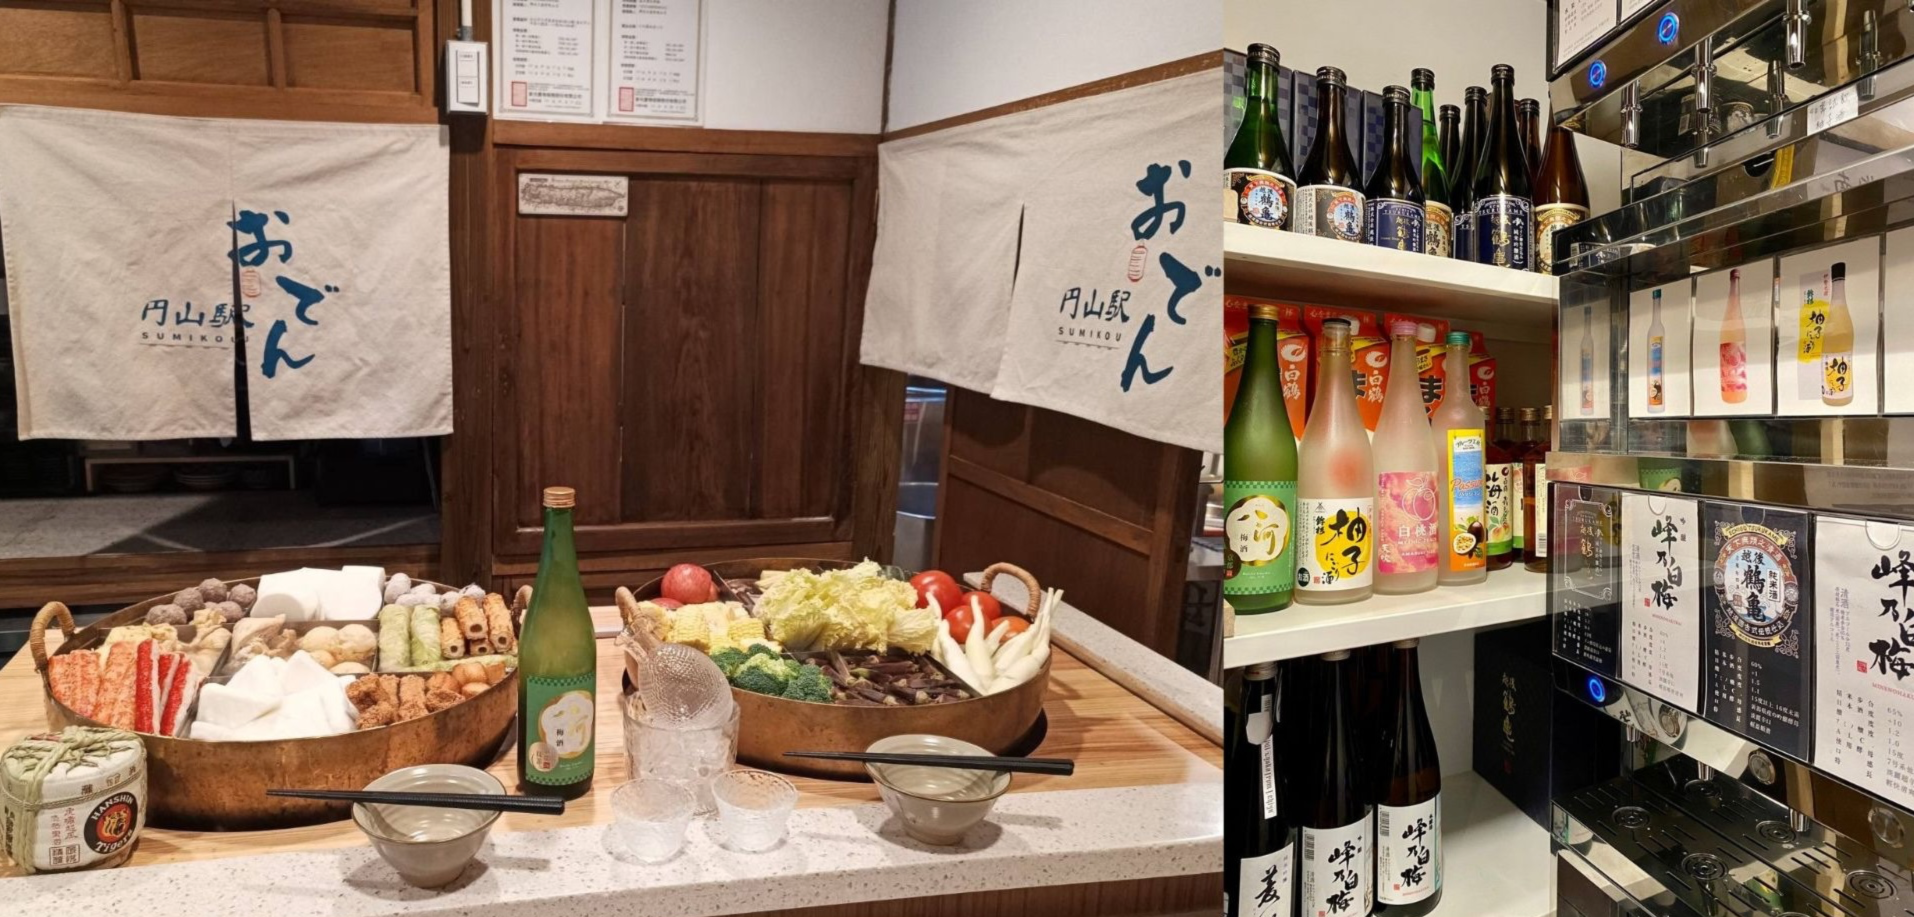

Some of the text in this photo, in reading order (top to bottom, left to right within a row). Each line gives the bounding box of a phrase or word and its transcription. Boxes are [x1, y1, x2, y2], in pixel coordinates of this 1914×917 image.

[1121, 160, 1221, 393] おでん
[226, 209, 340, 379] おでん
[1060, 287, 1131, 323] 円山駅
[141, 299, 255, 328] 円山駅
[1058, 327, 1122, 342] SUMIKOU
[1284, 364, 1301, 400] 白鶴
[1368, 370, 1384, 403] 白鶴
[1240, 533, 1248, 553] 梅酒
[1320, 507, 1367, 575] 柚子
[1322, 552, 1339, 584] にごり酒
[1741, 549, 1765, 566] 越後
[1741, 565, 1766, 622] 鶴亀
[1768, 570, 1778, 600] 純米酒
[1750, 661, 1762, 669] 60%
[91, 793, 133, 821] HANSHIN
[95, 829, 133, 853] Tigers
[1401, 818, 1430, 887] 峰乃白梅
[1326, 840, 1359, 915] 峰乃白梅
